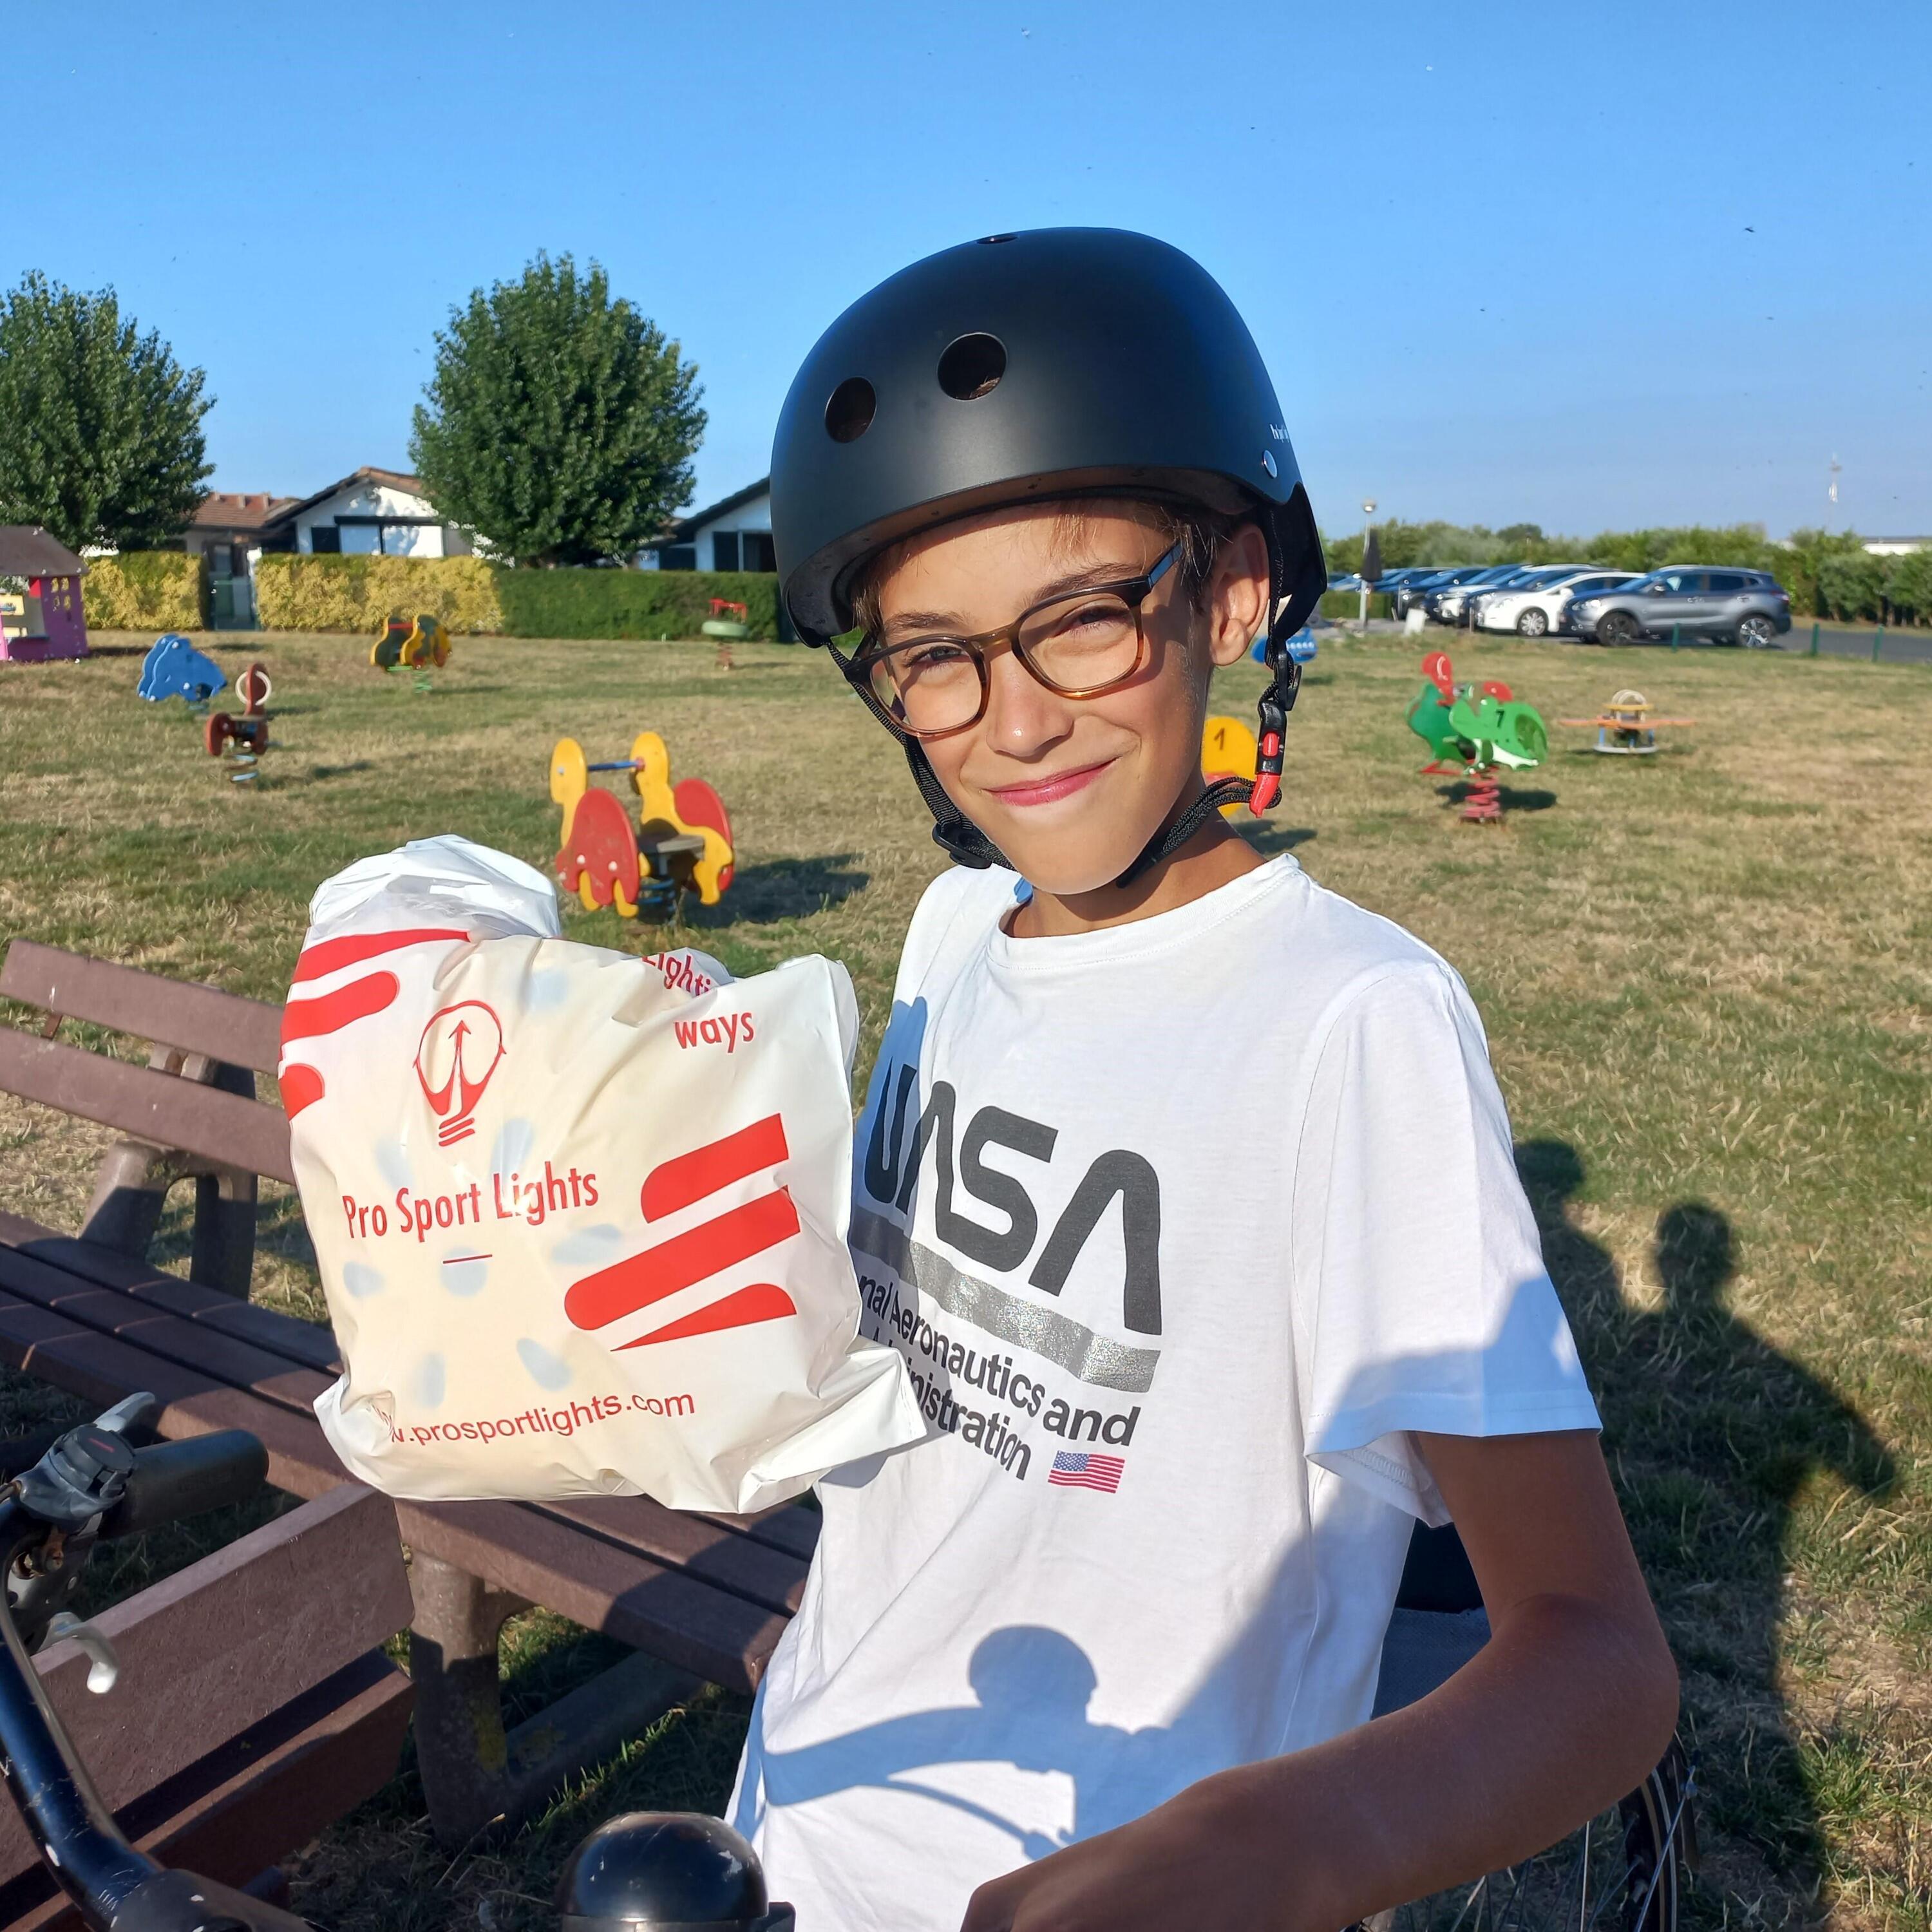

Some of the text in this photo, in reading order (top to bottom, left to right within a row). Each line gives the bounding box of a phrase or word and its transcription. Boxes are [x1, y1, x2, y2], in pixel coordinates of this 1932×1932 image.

[1213, 727, 1225, 751] 1
[1495, 708, 1505, 728] 7
[674, 1012, 754, 1054] ways
[342, 1160, 598, 1243] Pro Sport Lights
[864, 1056, 1162, 1336] NASA
[889, 1289, 1045, 1417] Aeronautics
[1043, 1397, 1141, 1446] and
